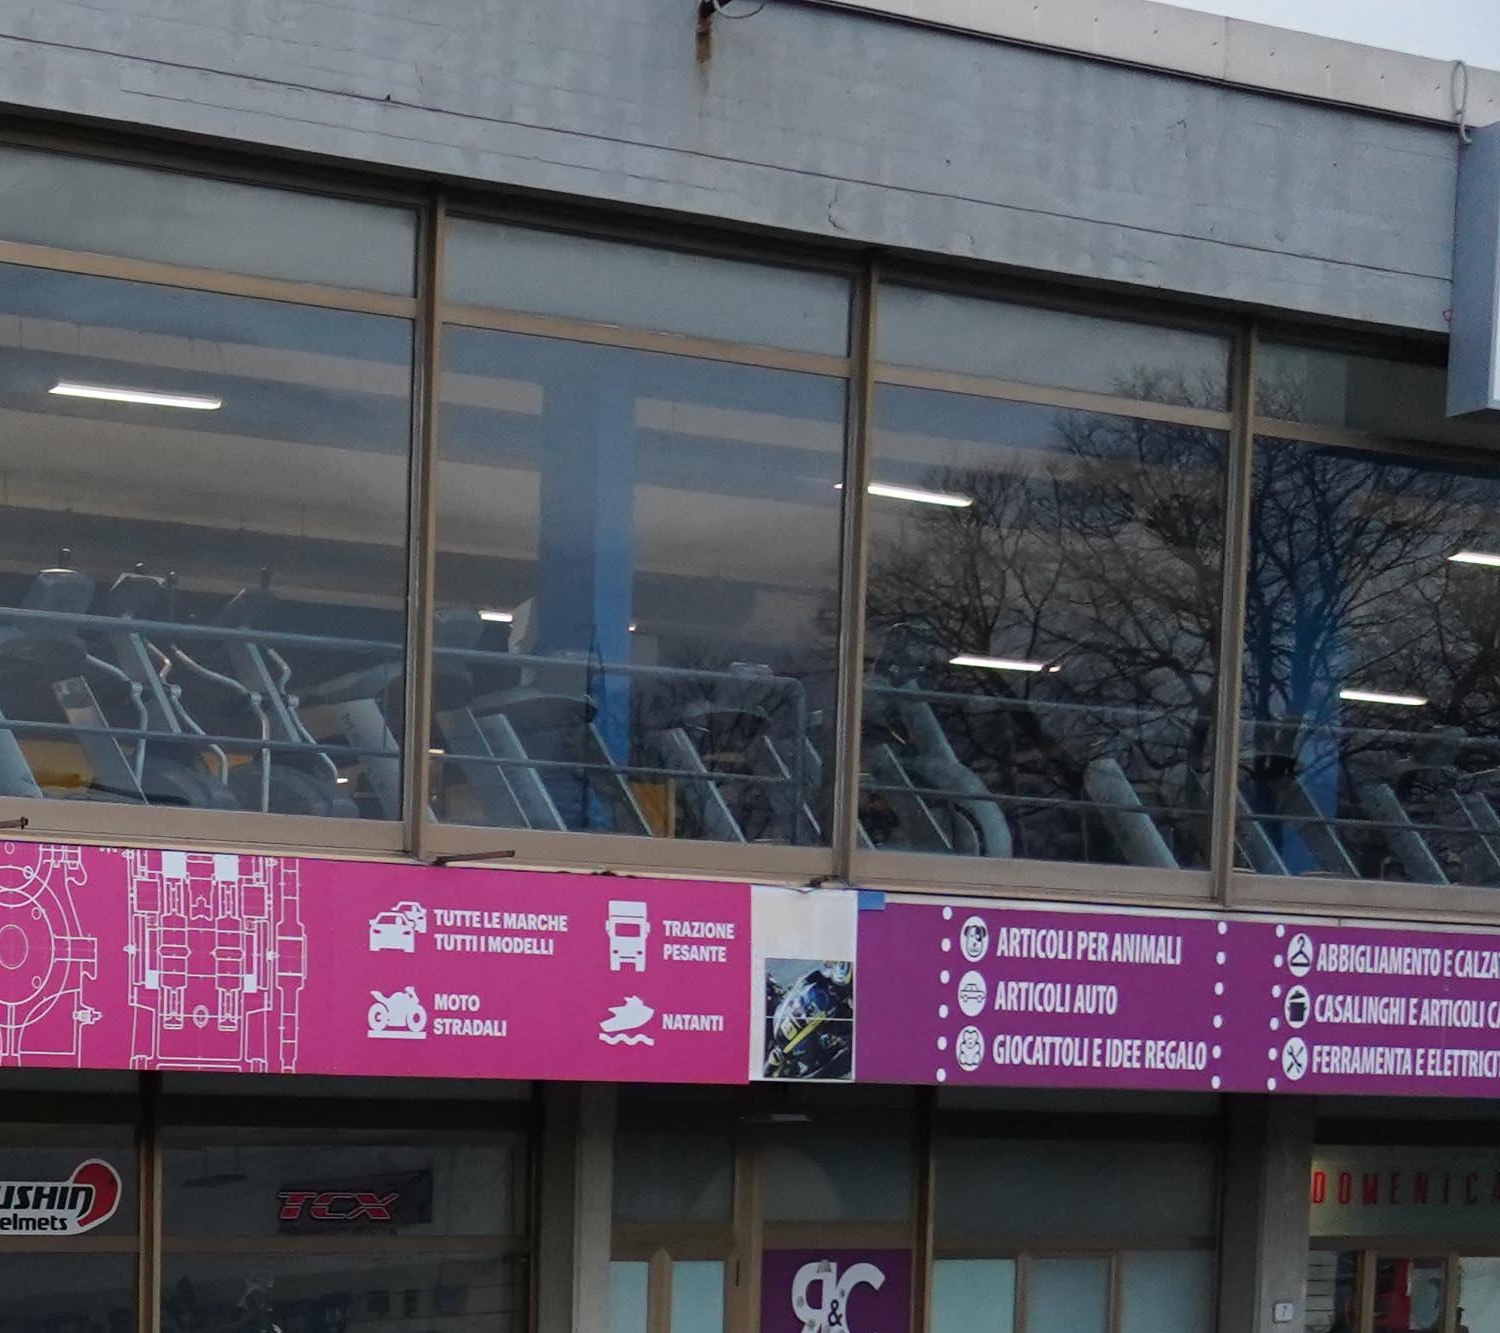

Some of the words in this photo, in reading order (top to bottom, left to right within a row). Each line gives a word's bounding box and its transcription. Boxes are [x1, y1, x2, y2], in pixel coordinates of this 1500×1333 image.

[434, 909, 481, 928] TUTTE
[484, 912, 500, 929] LE
[503, 913, 568, 932] MARCHE
[663, 920, 735, 940] TRAZIONE
[434, 934, 478, 952] TUTTI
[480, 936, 485, 952] I
[488, 936, 554, 955] MODELLI
[663, 944, 727, 963] PESANTE
[997, 927, 1073, 960] ARTICOLI
[1077, 931, 1108, 961] PER
[1111, 933, 1182, 965] ANIMALI
[1316, 943, 1440, 977] ABBIGLIAMENTO
[1444, 949, 1452, 977] E
[434, 994, 480, 1011] MOTO
[994, 981, 1070, 1013] ARTICOLI
[1073, 984, 1118, 1015] AUTO
[662, 1013, 724, 1032] NATANTI
[1314, 995, 1405, 1025] CASALINGHI
[1408, 998, 1418, 1026] E
[1419, 999, 1484, 1028] ARTICOLI
[433, 1018, 507, 1037] STRADALI
[993, 1034, 1088, 1067] GIOCATTOLI
[1092, 1038, 1102, 1067] E
[1105, 1039, 1141, 1069] IDEE
[1145, 1040, 1207, 1070] REGALO
[1312, 1045, 1412, 1076] FERRAMENTA
[1415, 1048, 1424, 1076] E
[277, 1191, 400, 1220] TCX
